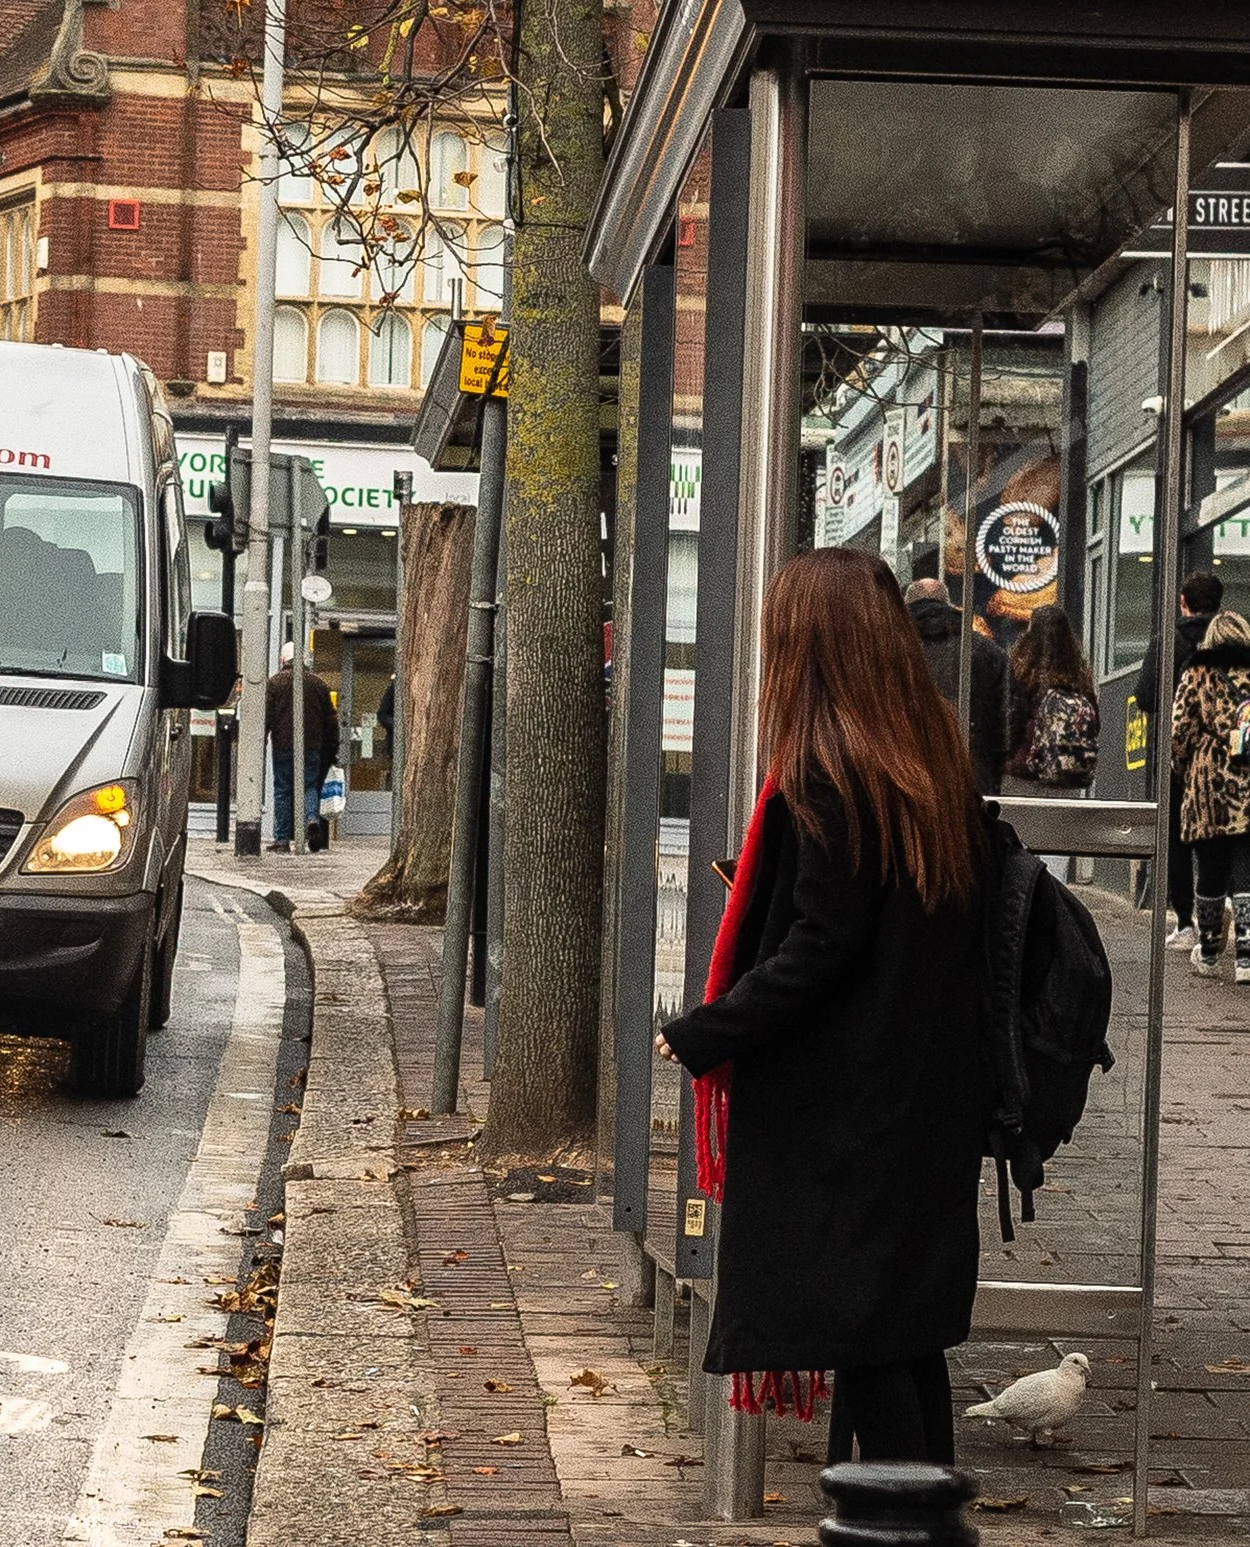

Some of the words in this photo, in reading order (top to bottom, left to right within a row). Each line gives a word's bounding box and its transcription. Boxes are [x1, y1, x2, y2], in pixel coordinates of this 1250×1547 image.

[465, 347, 477, 359] No
[322, 485, 417, 509] OCIET
[1002, 526, 1040, 536] OLDEST
[998, 535, 1043, 545] CORNISH
[988, 543, 1018, 553] PASTY
[1018, 545, 1053, 555] MAKER
[1004, 554, 1016, 563] IN
[1017, 554, 1036, 564] THE
[1001, 562, 1039, 573] WORLD
